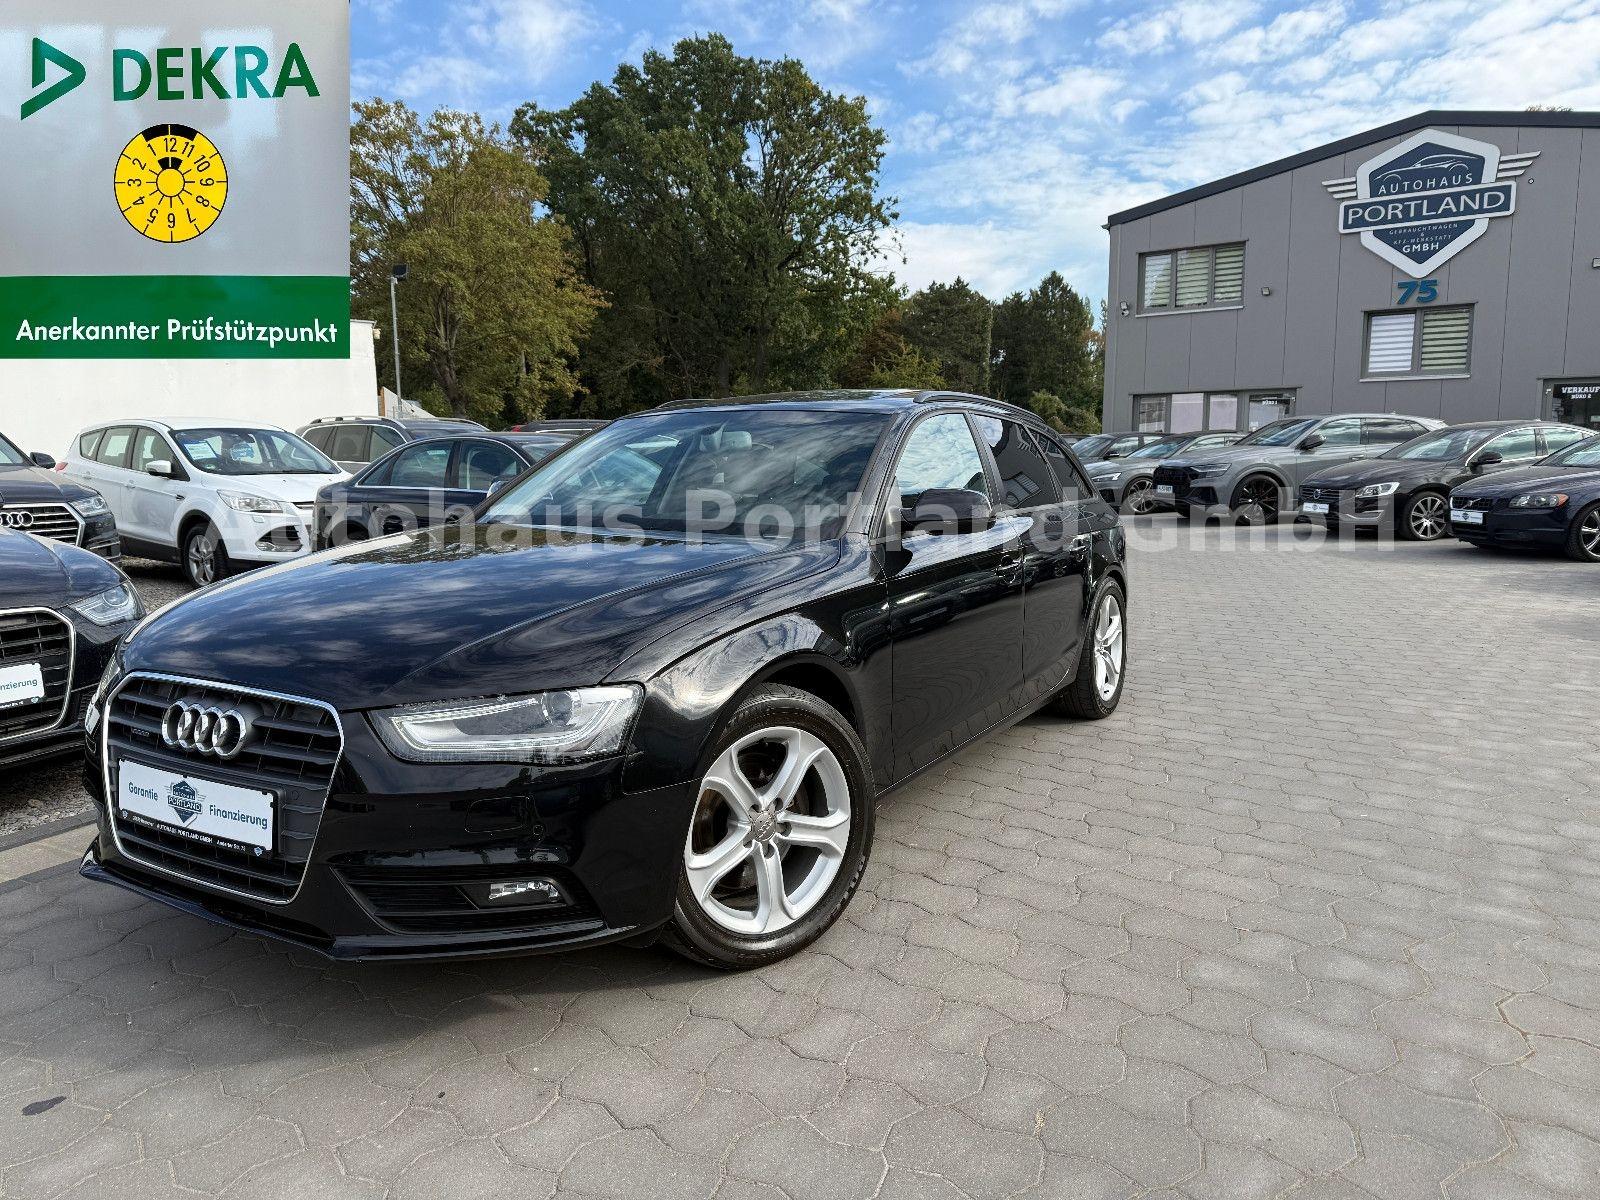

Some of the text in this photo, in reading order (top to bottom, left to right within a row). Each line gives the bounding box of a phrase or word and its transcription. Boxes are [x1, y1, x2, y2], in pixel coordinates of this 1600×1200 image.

[1378, 173, 1473, 195] AUTOHAUS
[1347, 191, 1505, 225] PORTLAND
[1402, 242, 1439, 253] GMBH
[1396, 279, 1438, 304] 75
[128, 782, 159, 801] Garantie
[168, 796, 201, 812] PORTLAND
[209, 804, 268, 830] Finanzierung
